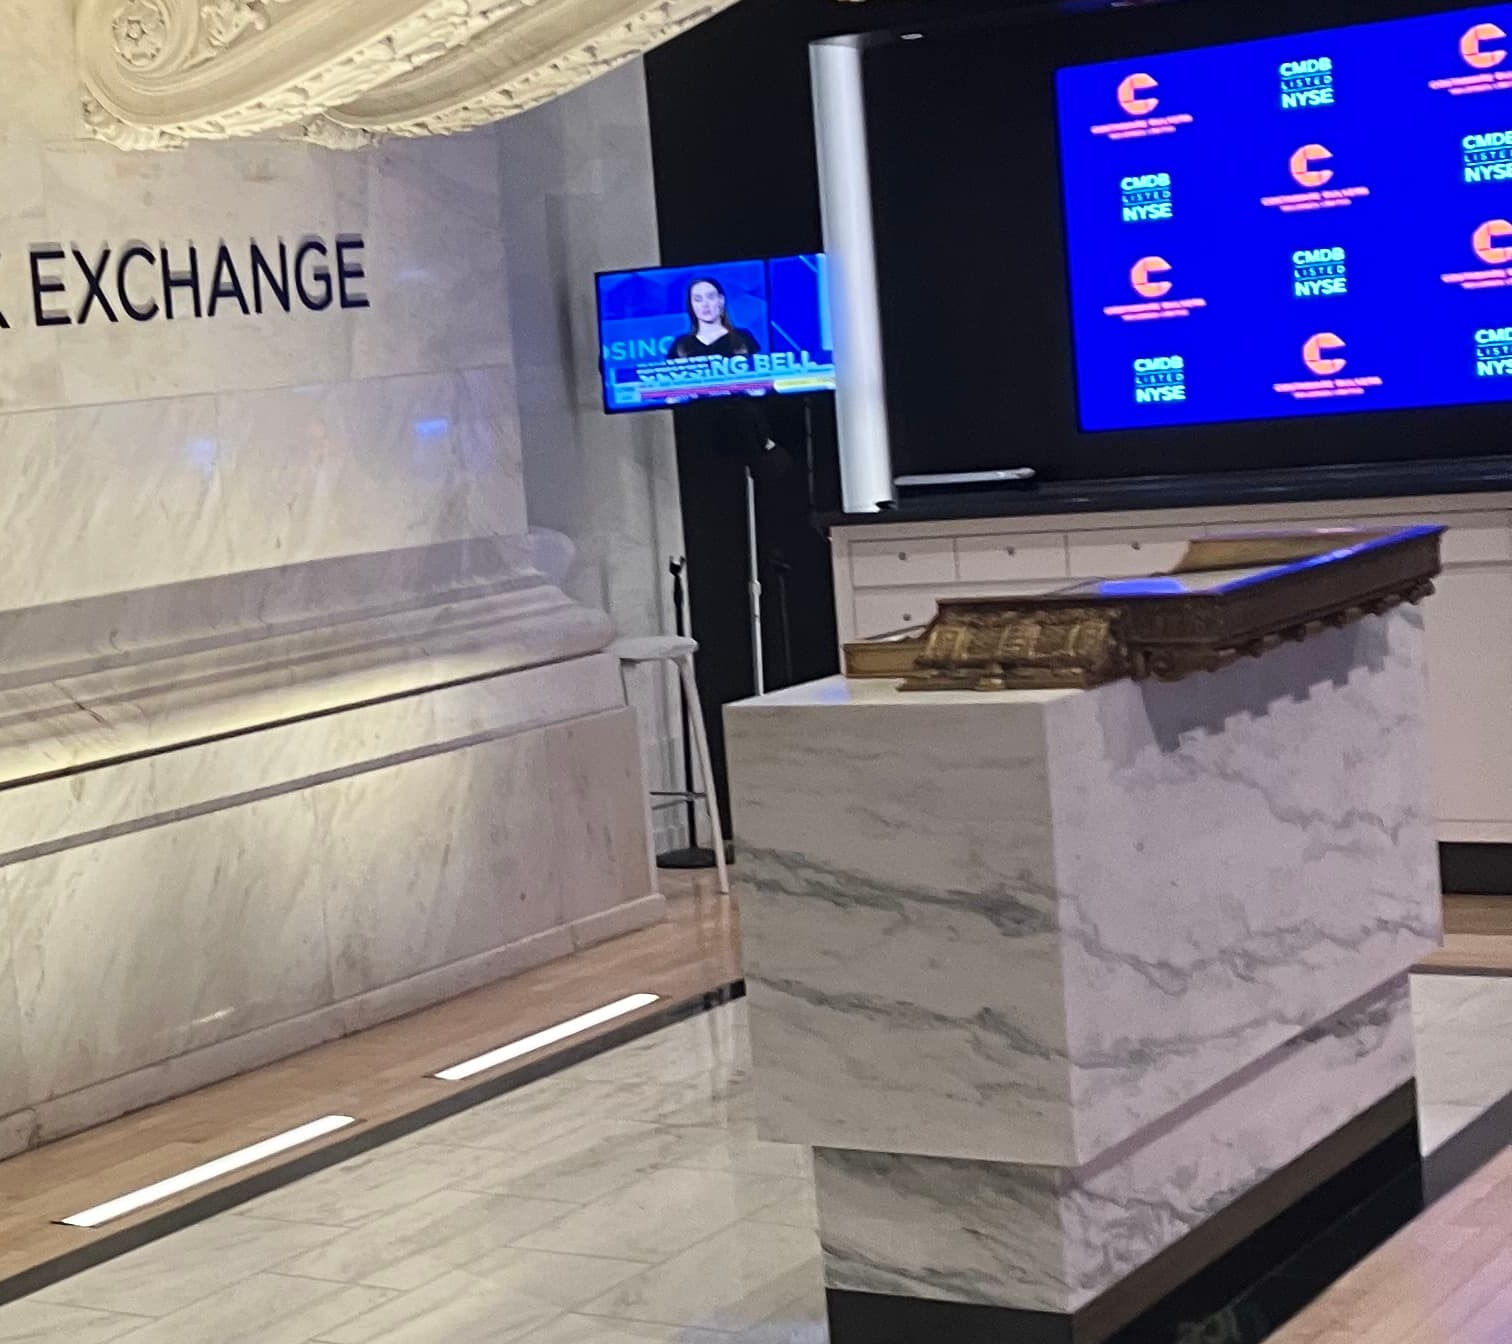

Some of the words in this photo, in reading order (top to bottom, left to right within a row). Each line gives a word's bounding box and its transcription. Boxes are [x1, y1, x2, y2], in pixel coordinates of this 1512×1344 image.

[1280, 56, 1333, 77] CMDB
[1281, 75, 1333, 90] LISTED
[1281, 87, 1335, 109] NYSE
[1120, 172, 1171, 191] CMDB
[1122, 202, 1174, 222] NYSE
[1292, 246, 1345, 265] CMDB
[1294, 264, 1346, 278] LISTED
[29, 239, 371, 327] EXCHANGE
[1294, 277, 1347, 297] NYSE
[753, 350, 817, 375] BELL
[1136, 384, 1187, 403] NYSE
